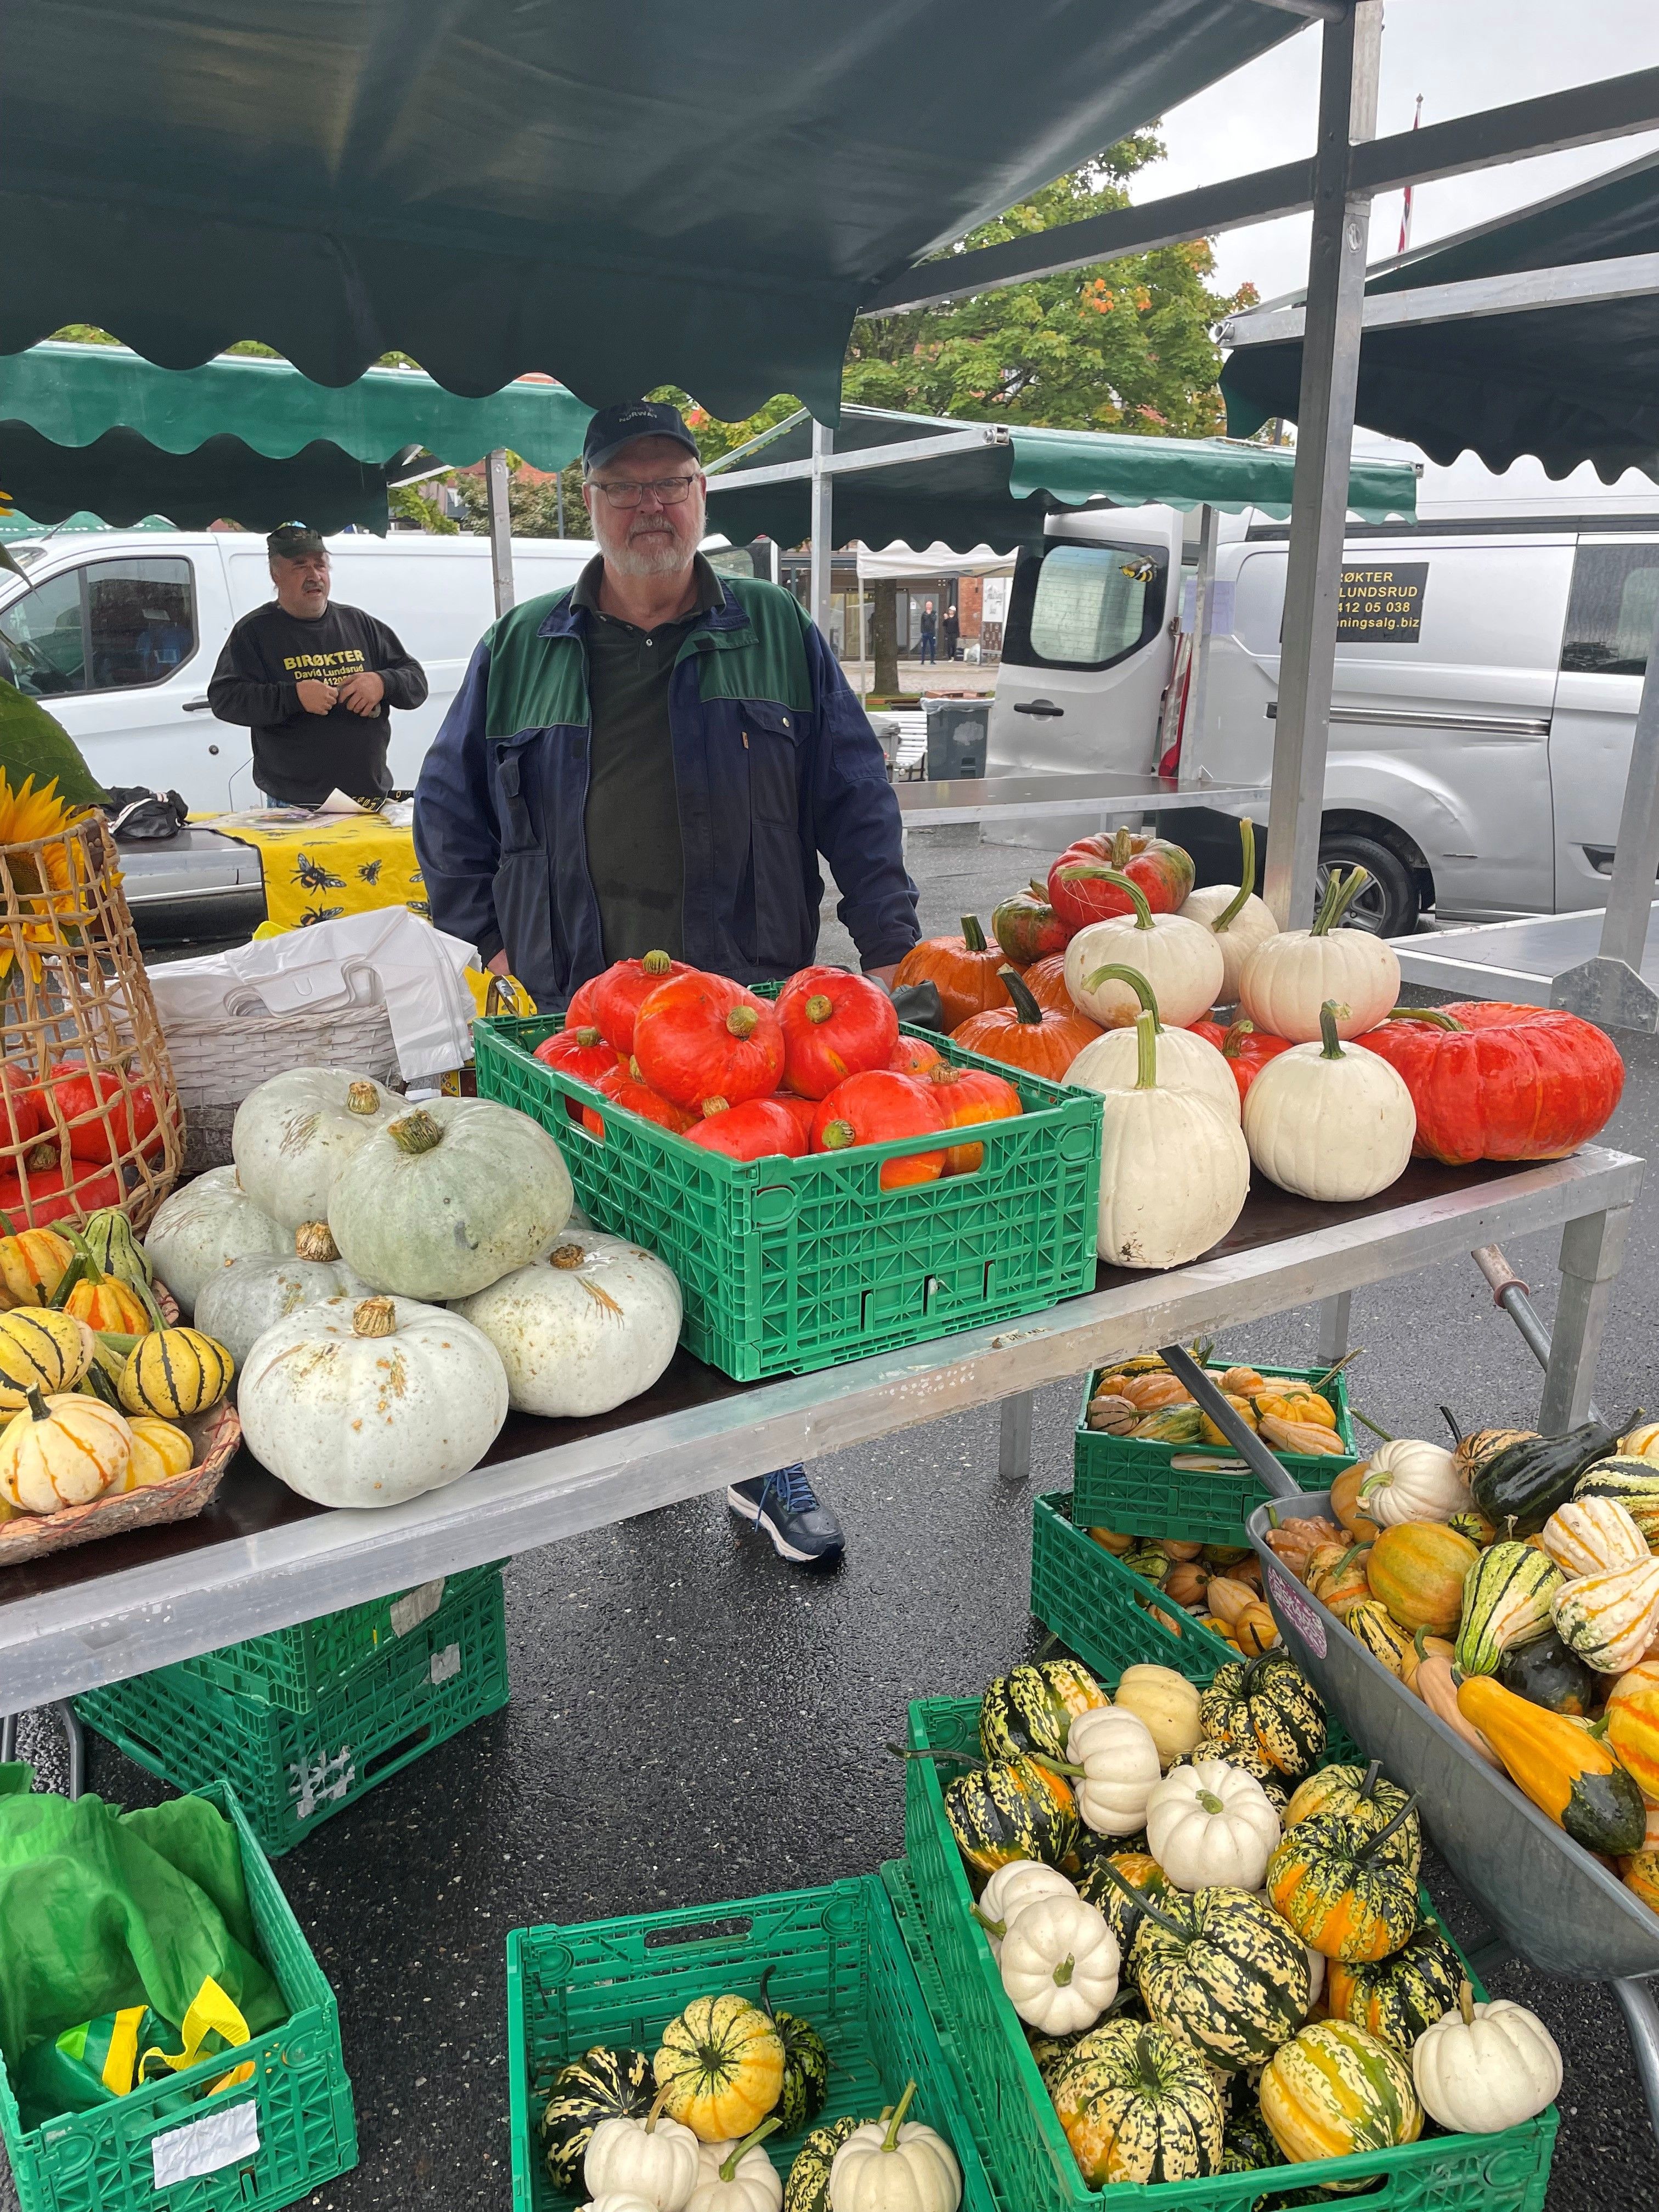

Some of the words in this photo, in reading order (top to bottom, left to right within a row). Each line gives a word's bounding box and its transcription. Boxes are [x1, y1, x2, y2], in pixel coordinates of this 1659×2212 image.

[1339, 586, 1418, 598] LUNDSRUD
[1338, 602, 1361, 613] 412
[1365, 602, 1381, 613] 05
[1386, 601, 1410, 613] 038
[1337, 617, 1420, 630] ningsalg.biz
[283, 650, 365, 670] BIRØKTER
[294, 668, 323, 680] David
[323, 664, 364, 676] Lundsrud
